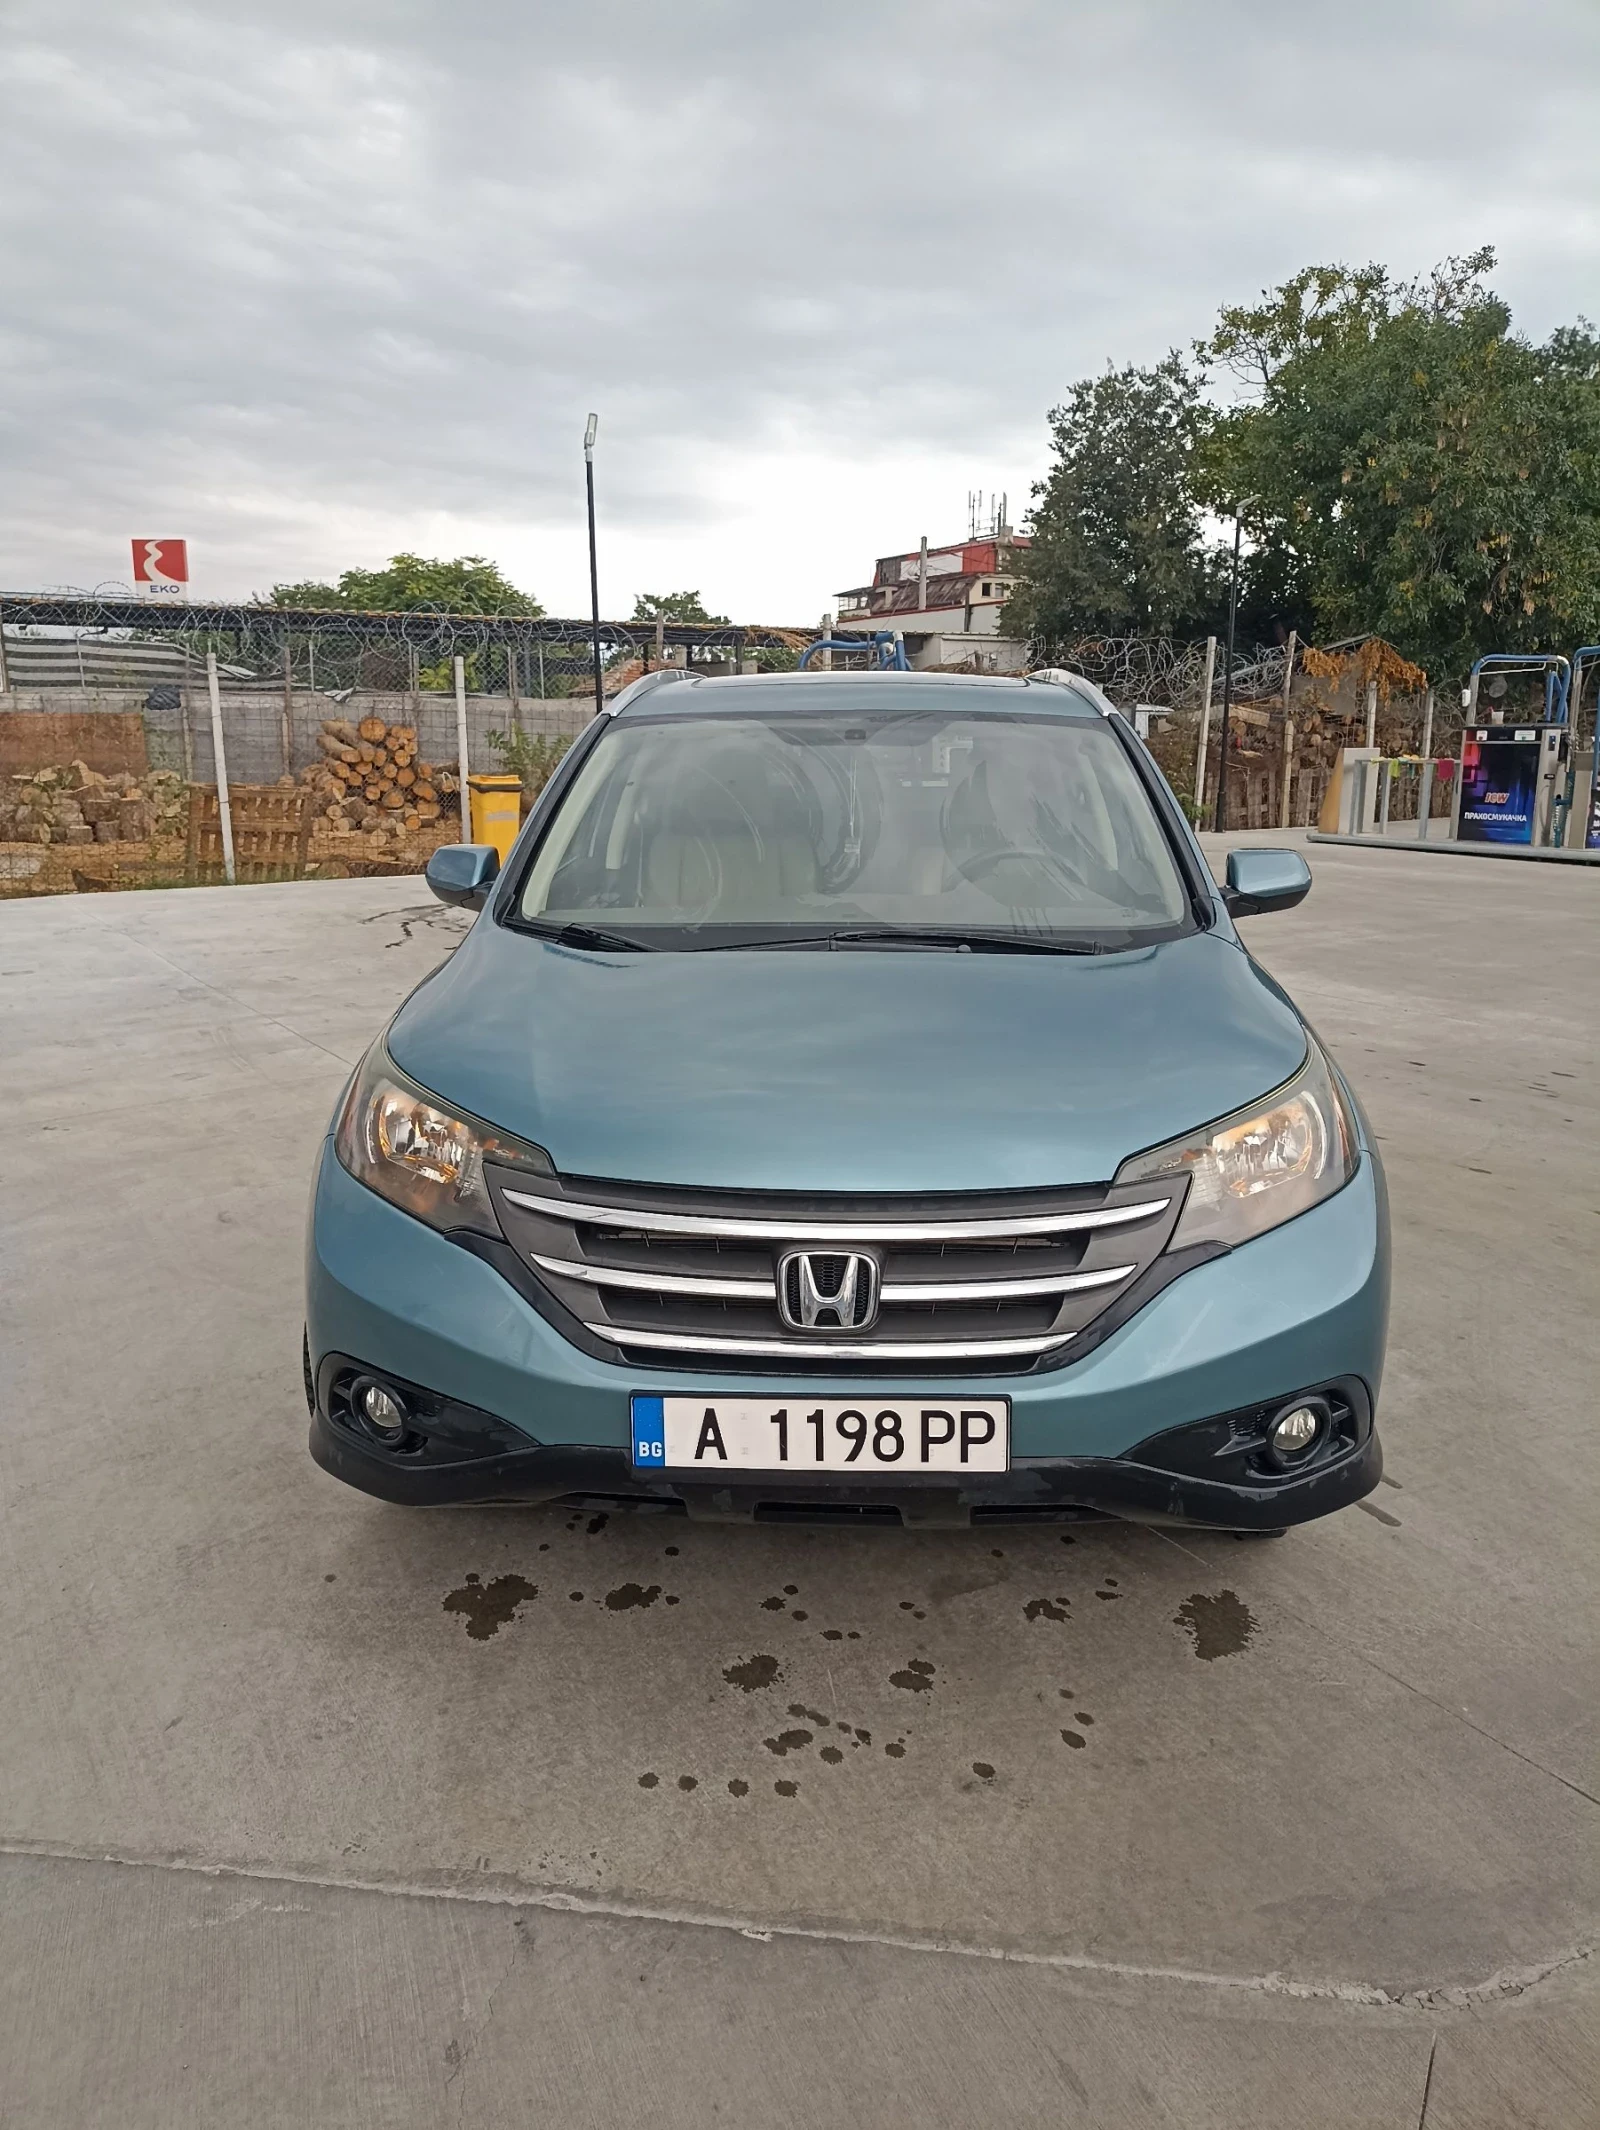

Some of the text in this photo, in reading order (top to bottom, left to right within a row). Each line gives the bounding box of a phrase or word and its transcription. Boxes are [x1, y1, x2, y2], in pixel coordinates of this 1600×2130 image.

[149, 584, 180, 594] EKO
[1464, 812, 1527, 822] ПРАХОСМУКАЧКА
[694, 1407, 728, 1460] A
[638, 1441, 663, 1458] BG
